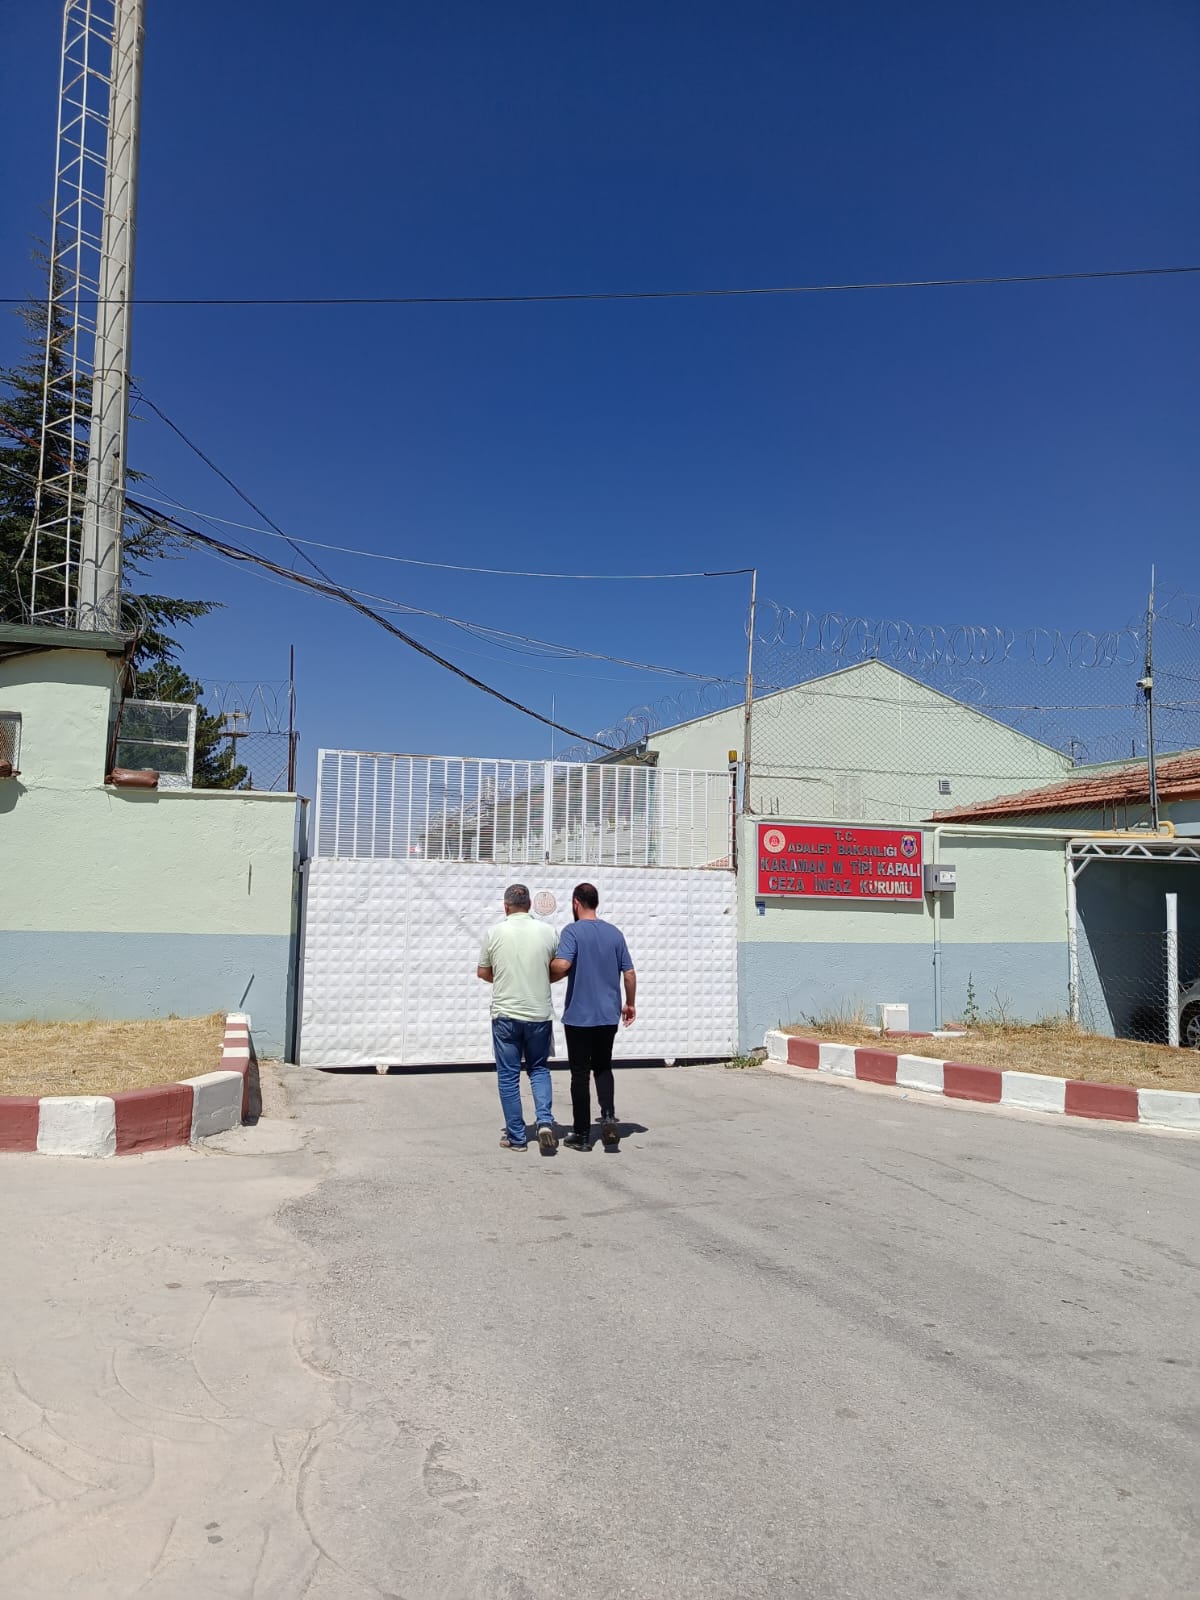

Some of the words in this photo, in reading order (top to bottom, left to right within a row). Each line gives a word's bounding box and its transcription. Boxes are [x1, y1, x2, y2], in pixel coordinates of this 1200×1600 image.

[834, 830, 857, 842] T.C.
[787, 842, 832, 855] ADALET
[838, 844, 898, 857] BAKANLIĞI
[760, 857, 827, 873] KARAMAN
[832, 861, 843, 874] M
[850, 859, 873, 875] TİPİ
[877, 861, 921, 877] KAPALI
[768, 876, 805, 892] CEZA
[813, 875, 852, 893] İNFAZ
[860, 880, 913, 895] KURUMU
